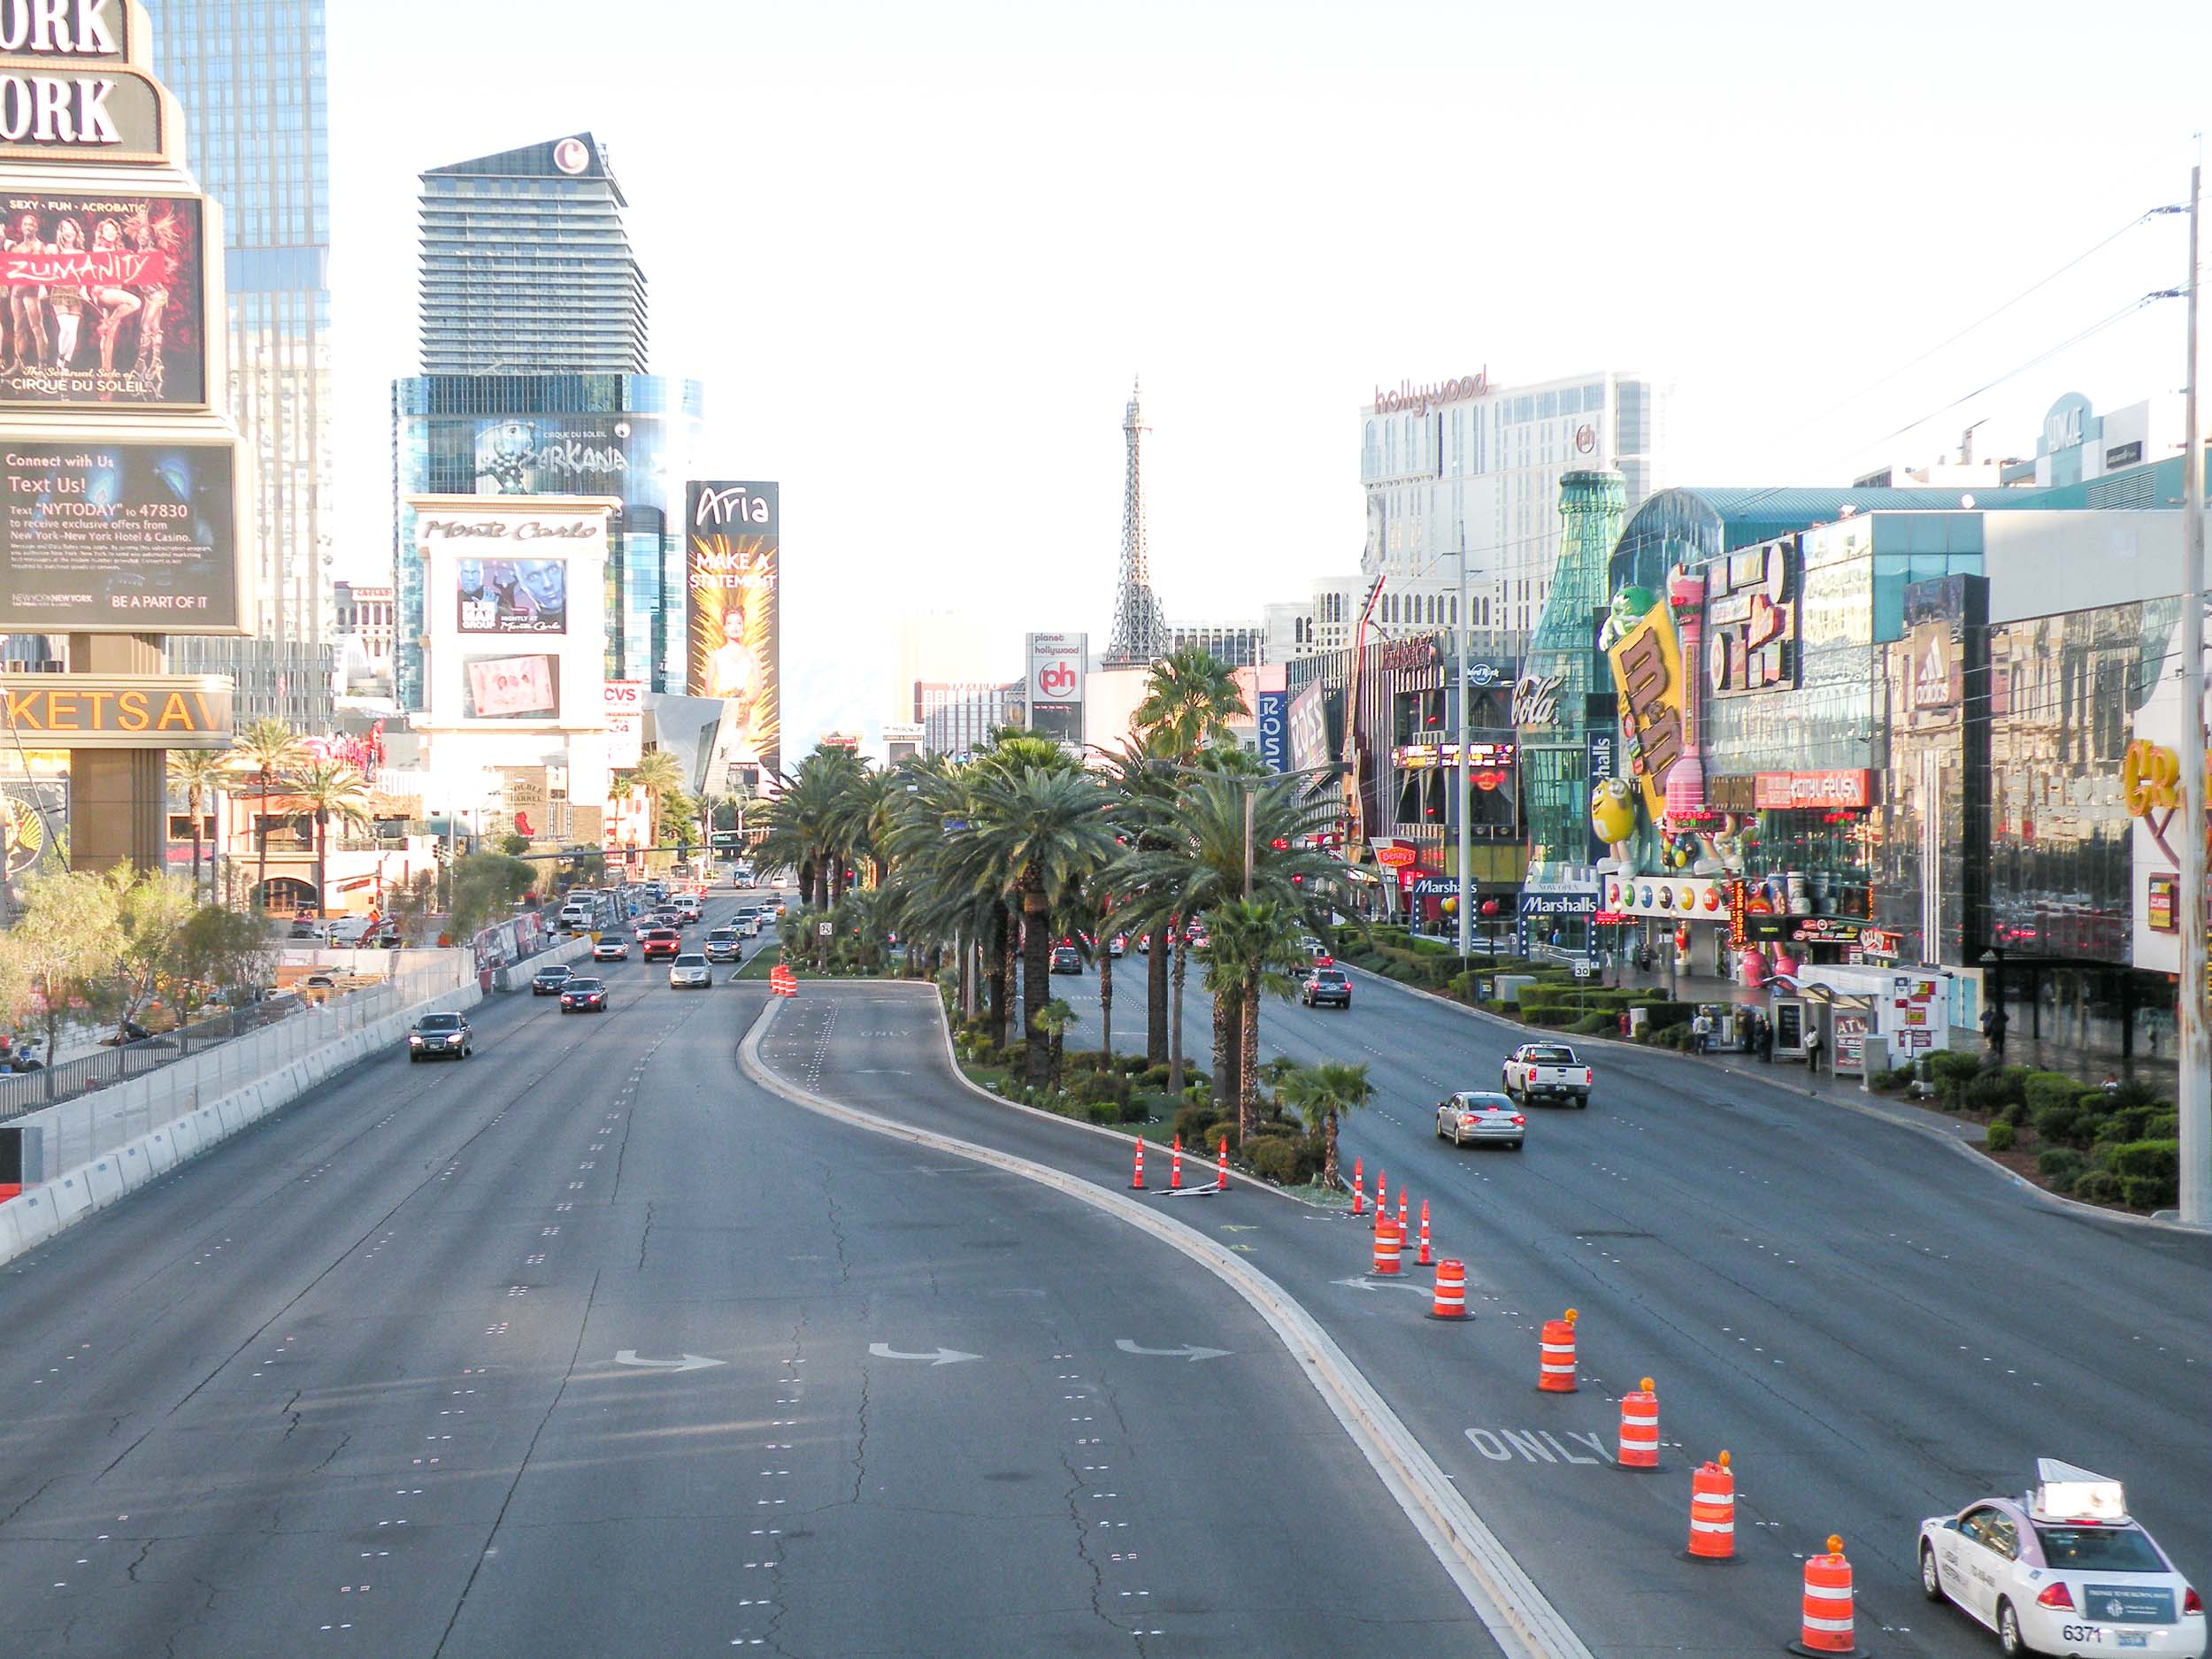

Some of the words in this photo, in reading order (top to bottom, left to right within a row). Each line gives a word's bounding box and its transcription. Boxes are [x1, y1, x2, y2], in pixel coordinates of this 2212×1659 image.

[10, 200, 39, 210] SEXY
[48, 202, 72, 211] FUN
[81, 203, 146, 213] ACROBATIC
[7, 251, 150, 284] ZUMANITY
[96, 368, 122, 379] Side
[12, 378, 66, 395] CIRQUE
[72, 380, 93, 392] DU
[96, 380, 147, 393] SOLEIL
[1374, 363, 1487, 419] hollywood
[543, 431, 571, 440] CIRQUE
[6, 453, 60, 467] Connect
[65, 454, 92, 467] with
[98, 456, 113, 468] Us
[8, 476, 50, 493] Text
[58, 478, 86, 494] Us!
[11, 507, 32, 516] Text
[126, 508, 136, 517] to
[140, 505, 188, 518] 47830
[696, 488, 769, 526] Aria
[62, 520, 108, 530] exclusive
[111, 521, 141, 530] offers
[425, 520, 511, 539] Monte
[514, 520, 596, 541] Carlo
[11, 533, 32, 541] New
[89, 533, 111, 542] York
[116, 534, 142, 542] Hotel
[155, 534, 191, 542] Casino.
[696, 553, 750, 570] MAKE
[755, 553, 771, 570] A
[112, 596, 127, 608] BE
[131, 596, 141, 608] A
[143, 596, 173, 608] PART
[176, 596, 196, 609] OF
[198, 597, 208, 609] IT
[462, 620, 495, 629] GROUP
[1035, 633, 1064, 643] planet
[1034, 646, 1079, 656] hollywood
[1041, 662, 1076, 693] ph
[604, 687, 636, 701] CVS
[1510, 673, 1566, 726] Cola
[3, 691, 150, 731] KETS
[1291, 691, 1323, 761] ROSS
[1593, 738, 1610, 776] halls
[1381, 850, 1413, 862] Denny's
[1416, 877, 1478, 894] Marshas
[1522, 896, 1596, 913] Marshalls
[1464, 1427, 1617, 1464] ONLY
[2062, 1624, 2102, 1643] 6371
